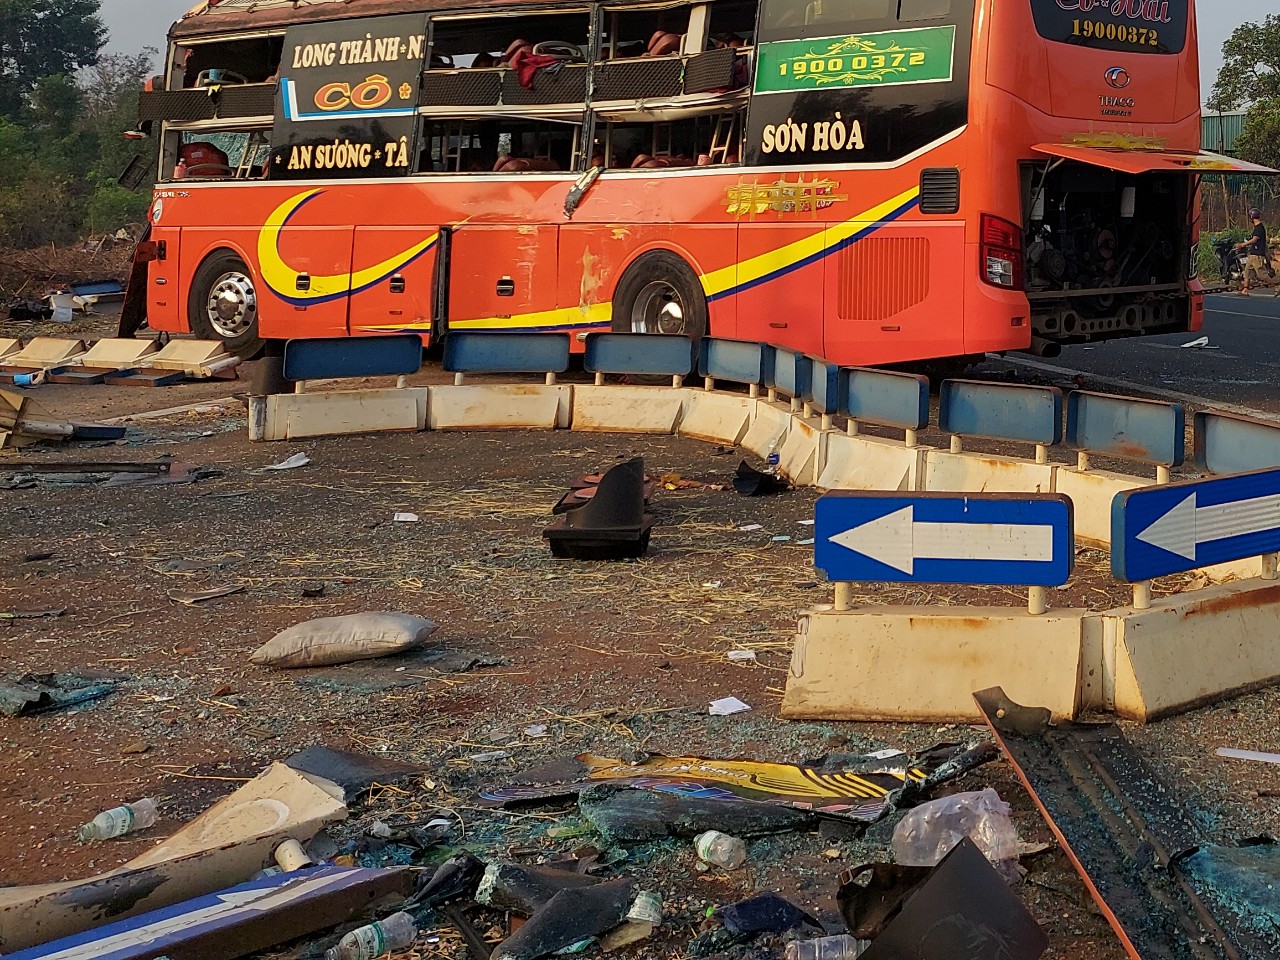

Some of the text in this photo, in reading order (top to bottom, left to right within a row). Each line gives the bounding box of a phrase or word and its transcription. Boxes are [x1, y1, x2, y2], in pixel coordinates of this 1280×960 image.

[1071, 18, 1158, 46] 19000372
[292, 43, 336, 68] LONG
[779, 52, 925, 76] 1900 0372
[314, 73, 392, 111] CÔ
[1098, 95, 1135, 108] THACO
[761, 111, 865, 153] SƠN HÒA
[287, 145, 313, 170] AN
[314, 138, 372, 170] SƯƠNG
